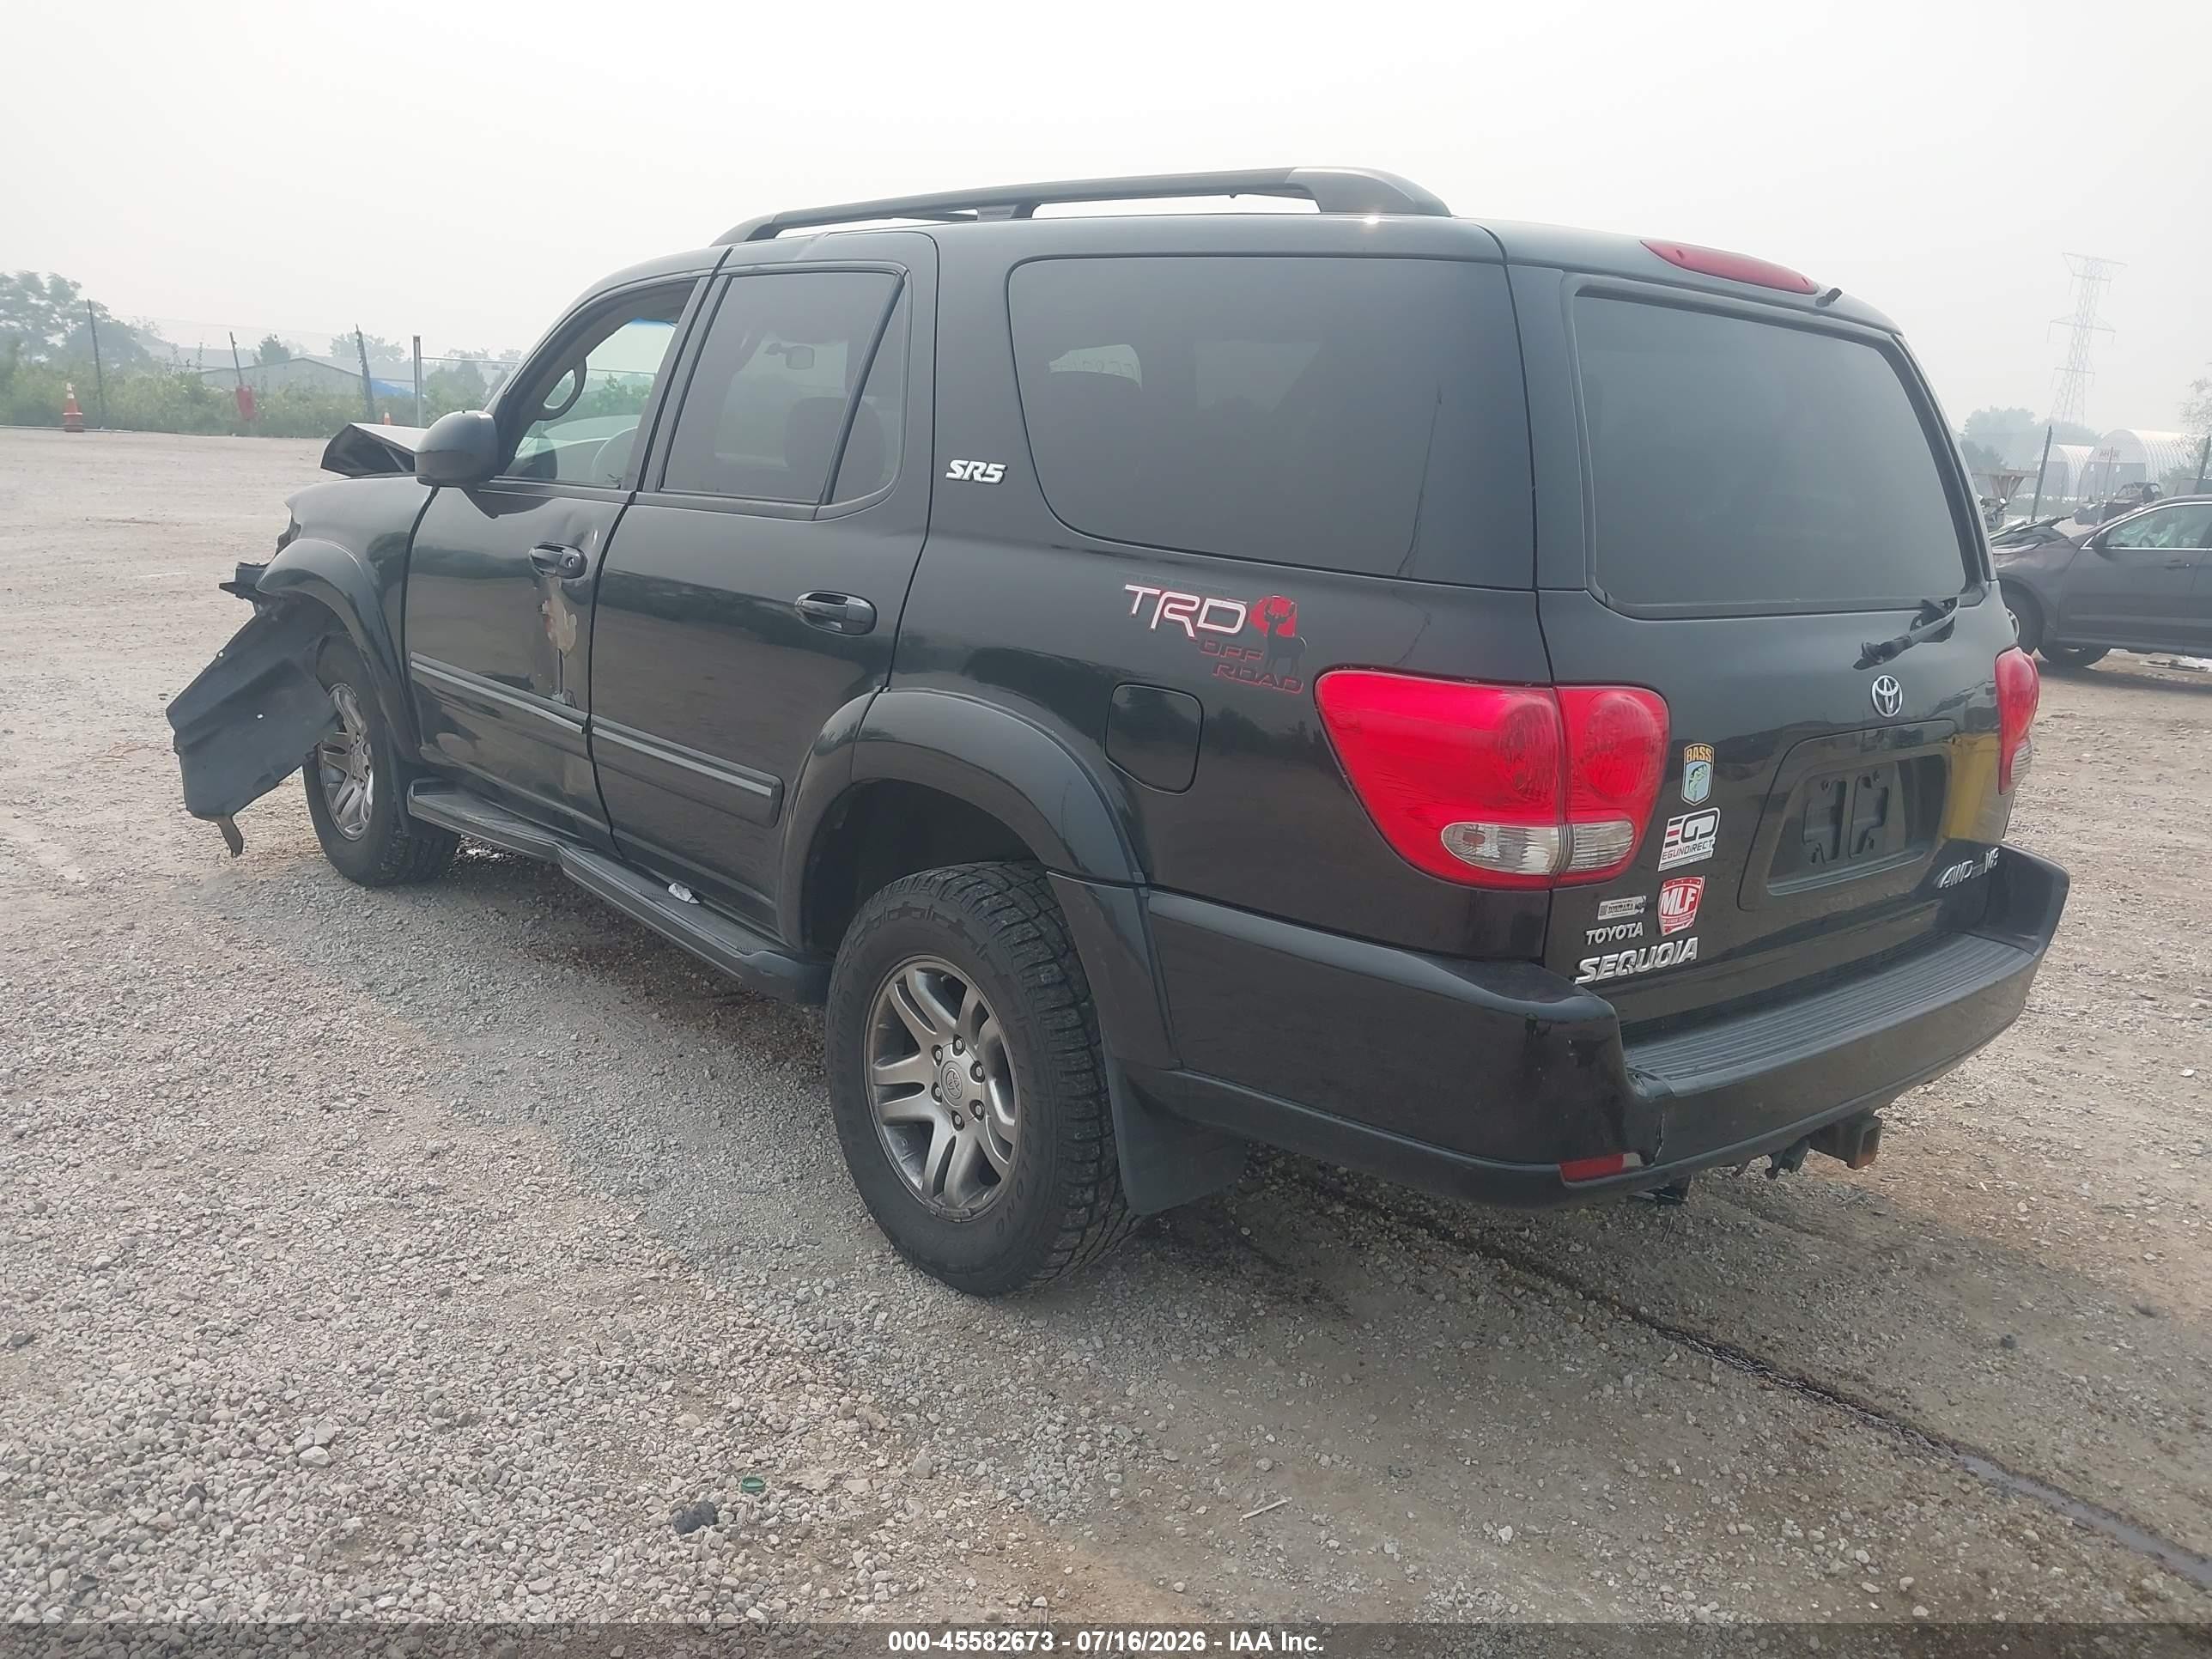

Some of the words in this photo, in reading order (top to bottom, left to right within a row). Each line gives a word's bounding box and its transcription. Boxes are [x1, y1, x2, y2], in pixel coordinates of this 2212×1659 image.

[945, 459, 1006, 483] SR5
[1124, 584, 1247, 638] TRD
[1200, 639, 1265, 661] OFF
[1212, 663, 1304, 695] ROAD
[1686, 746, 1712, 763] BASS
[1660, 885, 1698, 916] MLF
[1586, 921, 1644, 945] TOYOTA
[1574, 936, 1698, 985] SEQUOIA
